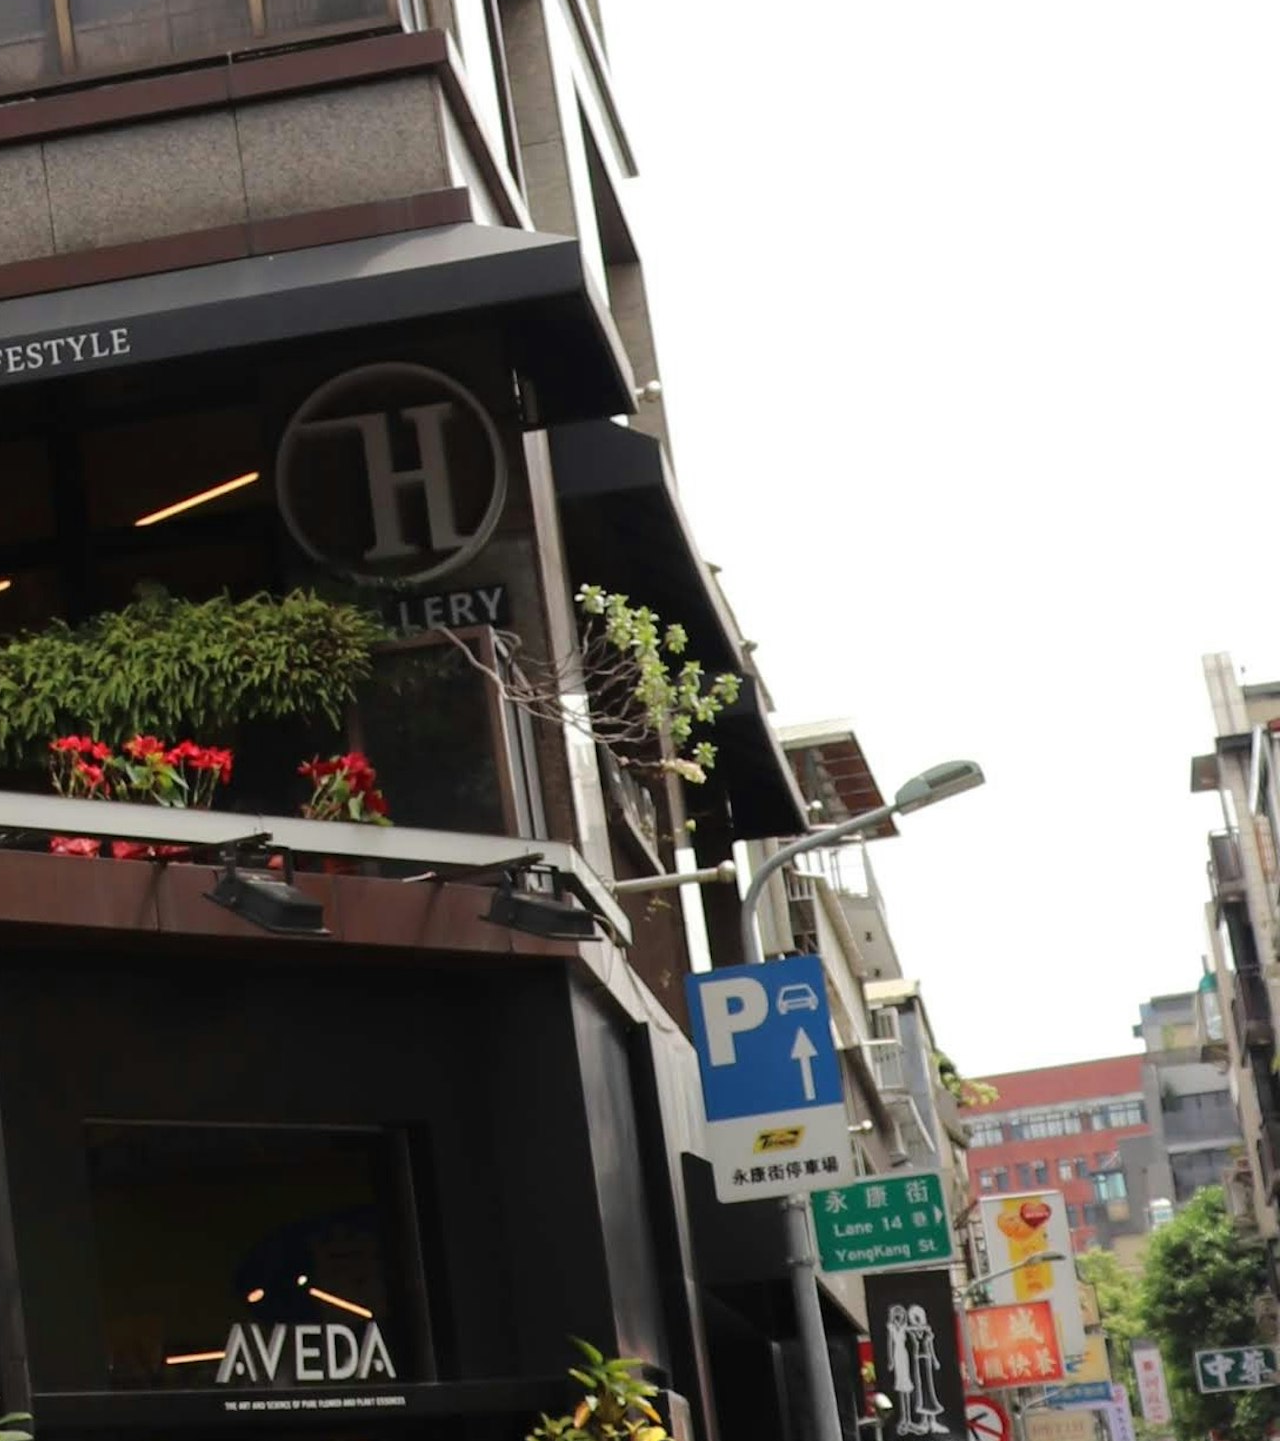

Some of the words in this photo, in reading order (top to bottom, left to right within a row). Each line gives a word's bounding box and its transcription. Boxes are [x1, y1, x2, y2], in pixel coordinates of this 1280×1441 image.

[390, 586, 503, 633] LERY
[699, 976, 769, 1068] P
[732, 1156, 840, 1187] 永康街停車場
[825, 1178, 929, 1214] 永康街
[833, 1221, 873, 1238] Lane
[882, 1215, 903, 1232] 14
[834, 1243, 911, 1263] YongKang
[215, 1321, 398, 1384] AVEDA
